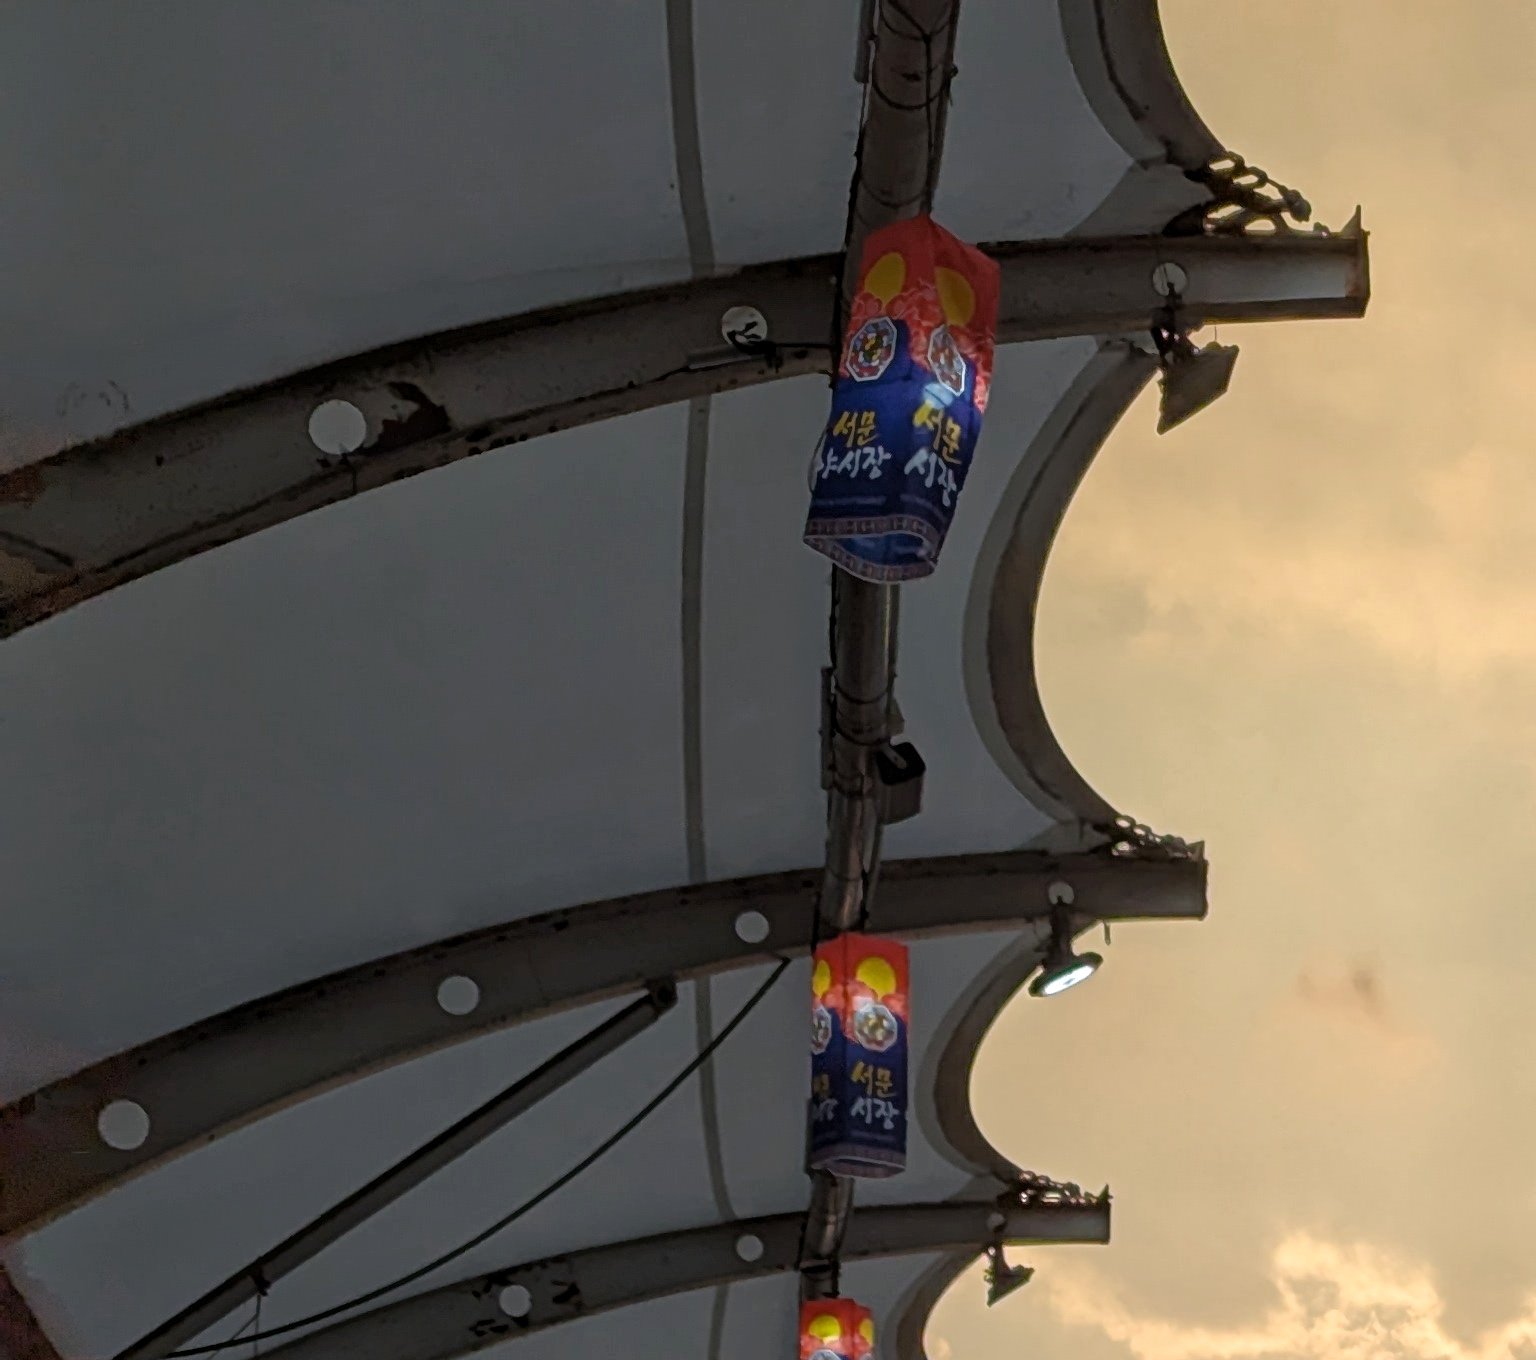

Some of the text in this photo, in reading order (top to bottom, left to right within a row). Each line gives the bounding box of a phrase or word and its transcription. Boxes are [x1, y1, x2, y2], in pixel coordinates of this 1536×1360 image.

[833, 411, 879, 447] 서문
[911, 403, 962, 465] 서문
[903, 450, 959, 507] 시장
[849, 1060, 897, 1099] 서문
[849, 1096, 900, 1131] 시장
